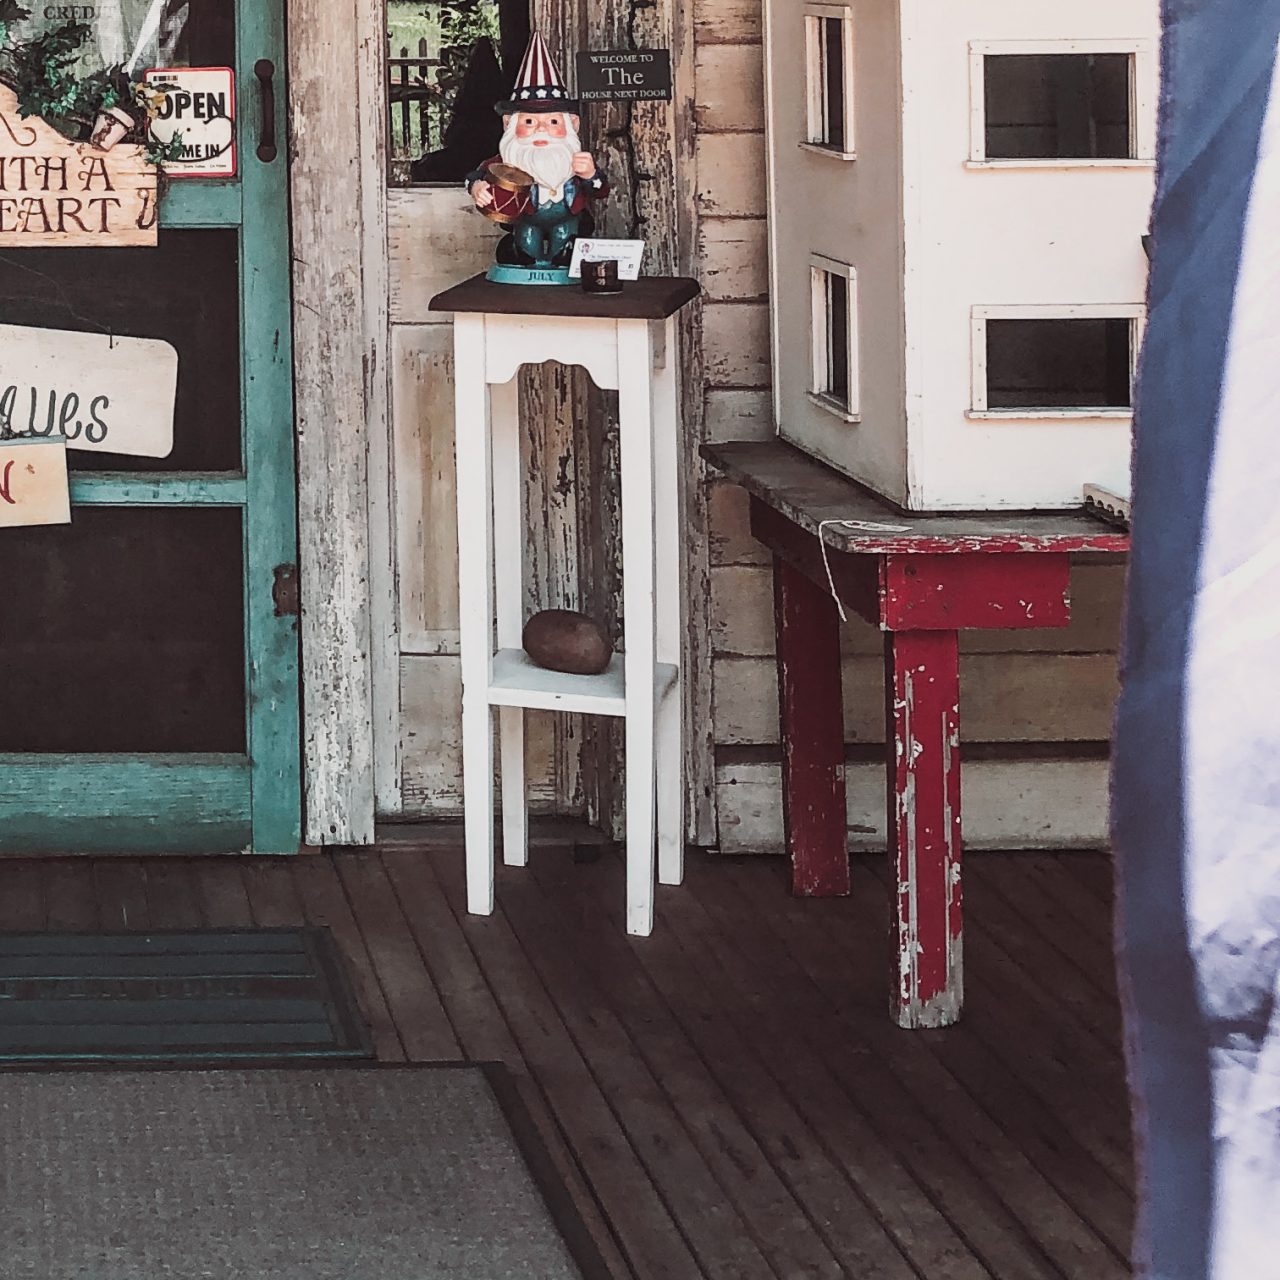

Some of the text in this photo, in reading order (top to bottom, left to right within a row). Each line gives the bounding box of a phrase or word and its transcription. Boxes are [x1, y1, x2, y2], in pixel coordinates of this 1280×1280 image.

[590, 54, 654, 64] WELCOME TO
[601, 67, 645, 86] The
[581, 89, 667, 99] HOUSE NEXT DOOR
[157, 91, 226, 120] OPEN
[205, 143, 220, 158] IN
[77, 155, 116, 192] A
[527, 271, 556, 282] JULY
